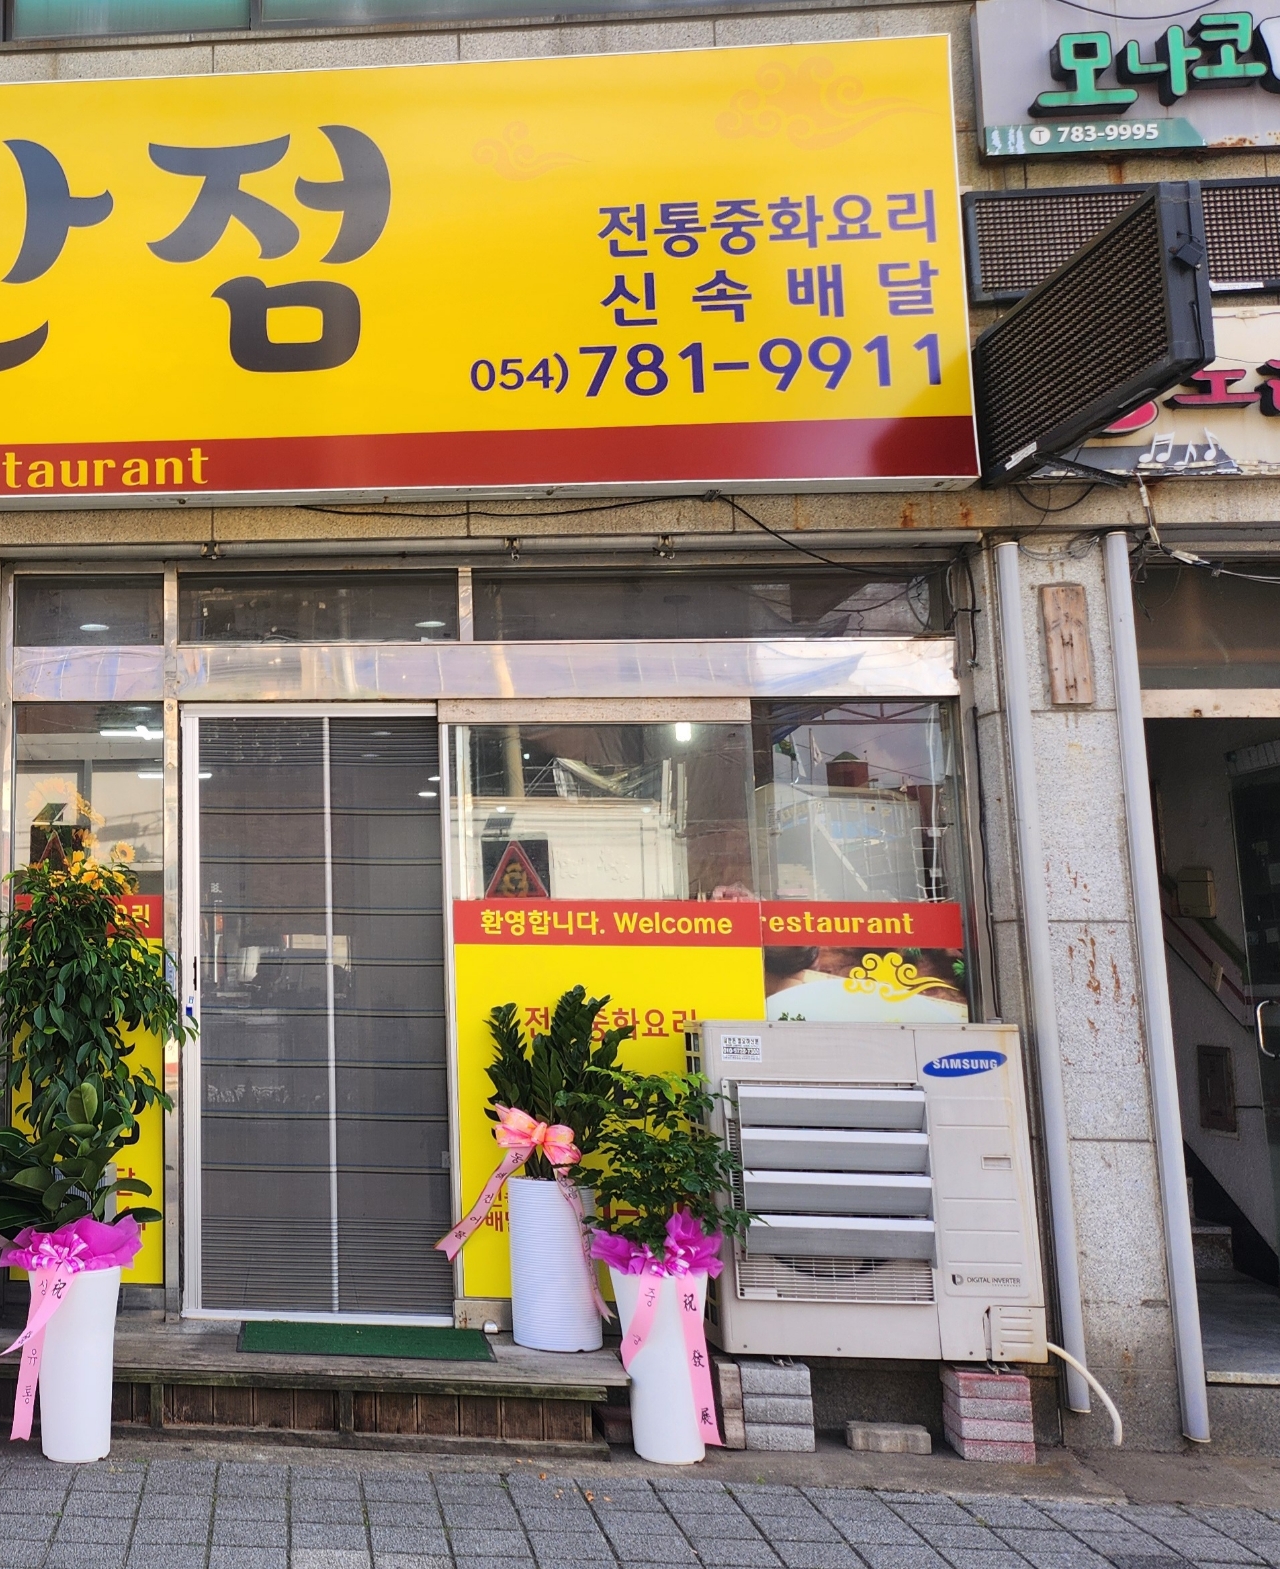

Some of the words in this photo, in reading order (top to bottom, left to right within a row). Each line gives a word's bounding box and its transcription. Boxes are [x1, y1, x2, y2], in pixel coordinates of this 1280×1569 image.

[1036, 11, 1268, 108] 모나코
[1056, 123, 1160, 144] 783-9995
[598, 188, 938, 258] 전통중화요리
[578, 332, 943, 398] 781-9911
[480, 908, 606, 936] 환영합니다.
[613, 911, 733, 935] Welcome
[759, 912, 914, 935] estaurant
[524, 1006, 697, 1042] 전중화요리
[932, 1057, 999, 1070] SAMSUNG
[966, 1276, 991, 1284] DIGITAL
[992, 1277, 1021, 1285] INVERTER
